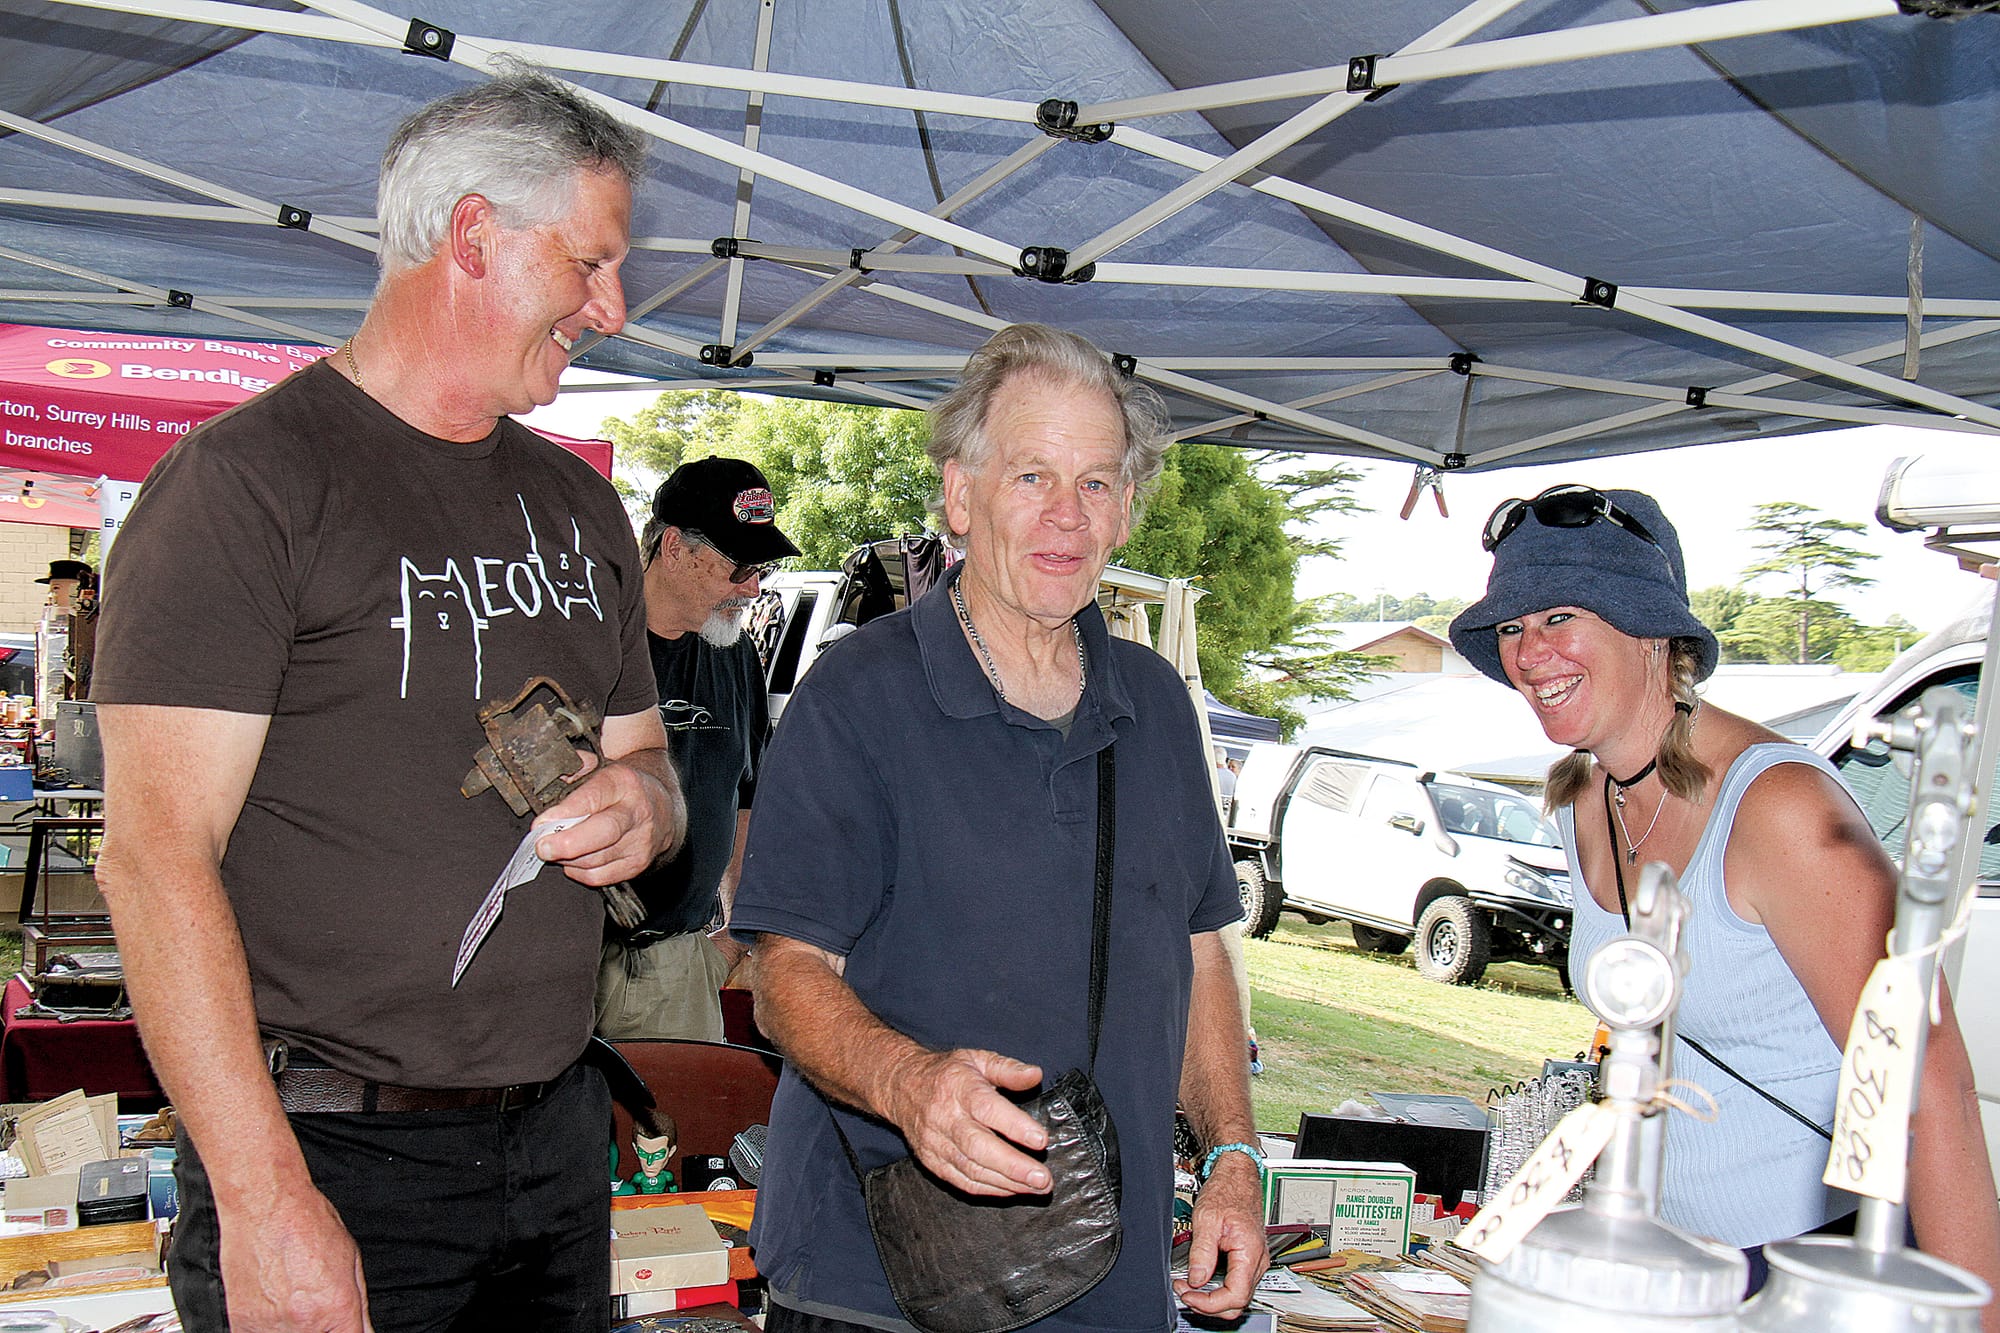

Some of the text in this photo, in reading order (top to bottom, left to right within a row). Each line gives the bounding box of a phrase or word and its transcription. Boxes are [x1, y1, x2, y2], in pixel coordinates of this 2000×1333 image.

[47, 338, 196, 352] Community
[46, 405, 107, 430] Surrey
[111, 412, 151, 432] Hills
[156, 418, 191, 436] and
[5, 430, 93, 455] branches
[1346, 1195, 1394, 1205] RANGE DOUBLER
[1335, 1204, 1403, 1220] MULTITESTER
